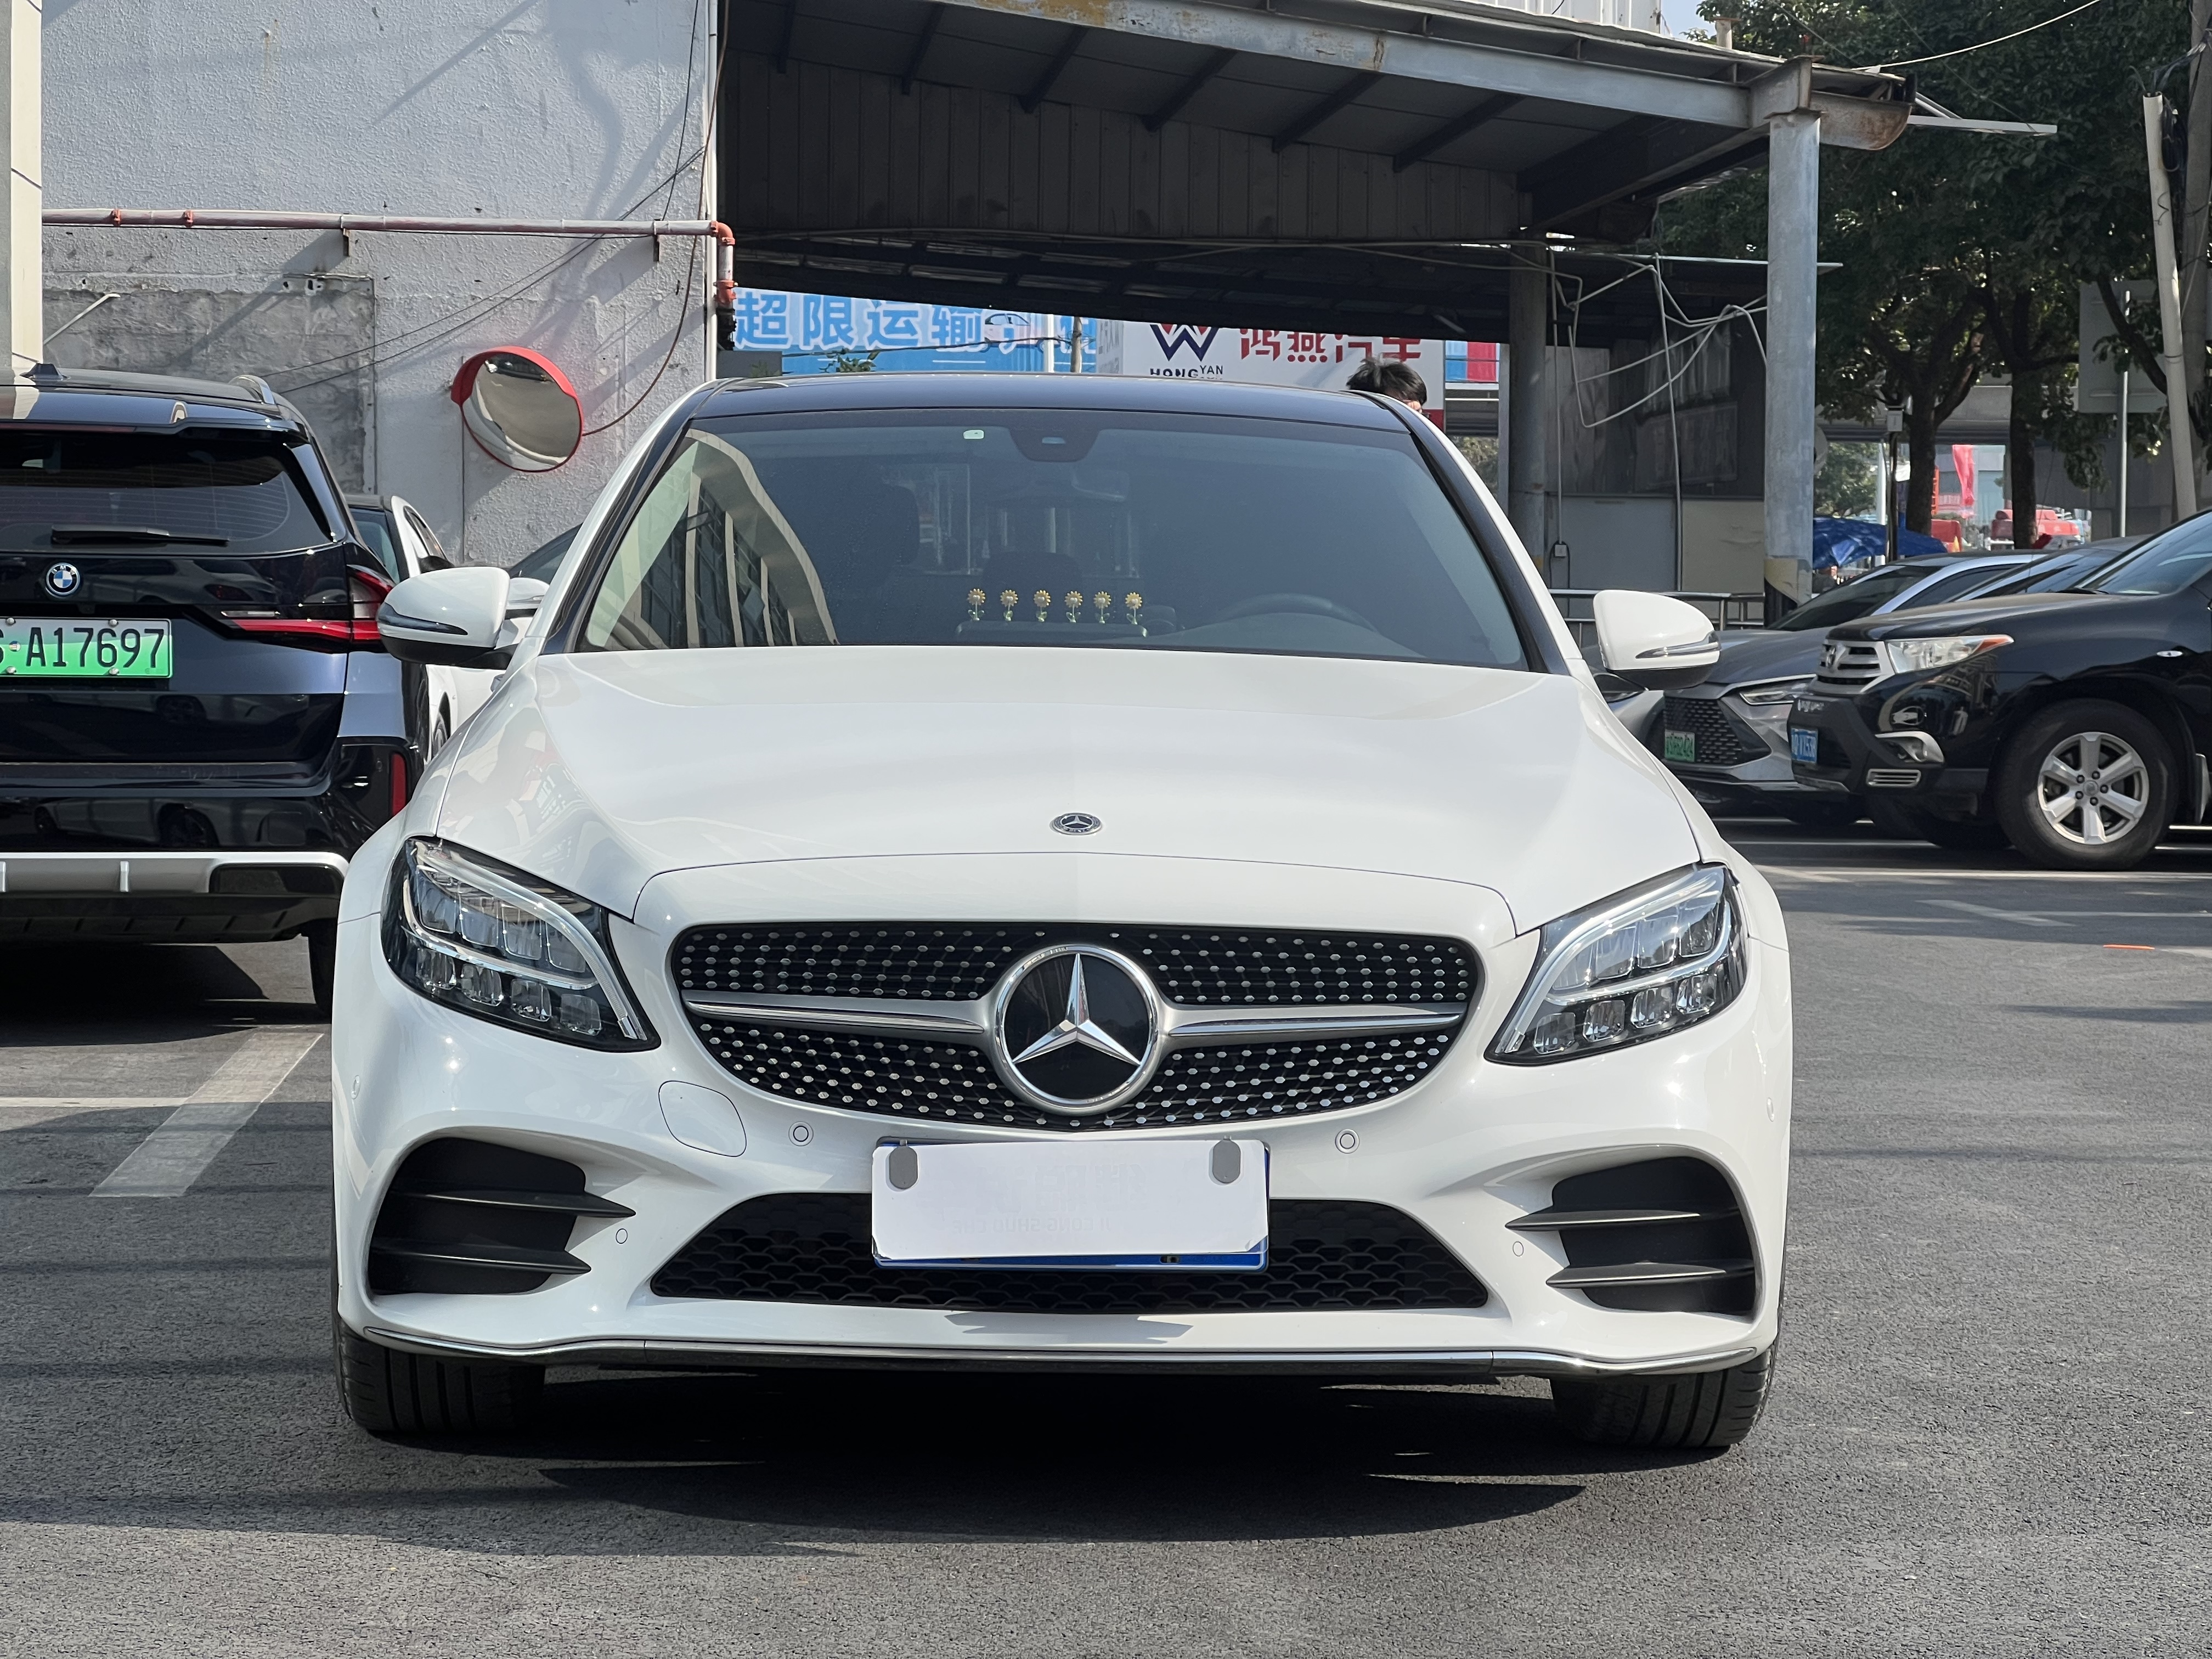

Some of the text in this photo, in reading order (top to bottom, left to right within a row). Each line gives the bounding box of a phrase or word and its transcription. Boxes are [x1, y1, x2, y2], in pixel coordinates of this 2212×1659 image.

[735, 292, 1096, 350] 超限运输
[1239, 328, 1421, 363] 鸿燕汽车
[0, 627, 165, 668] A17697
